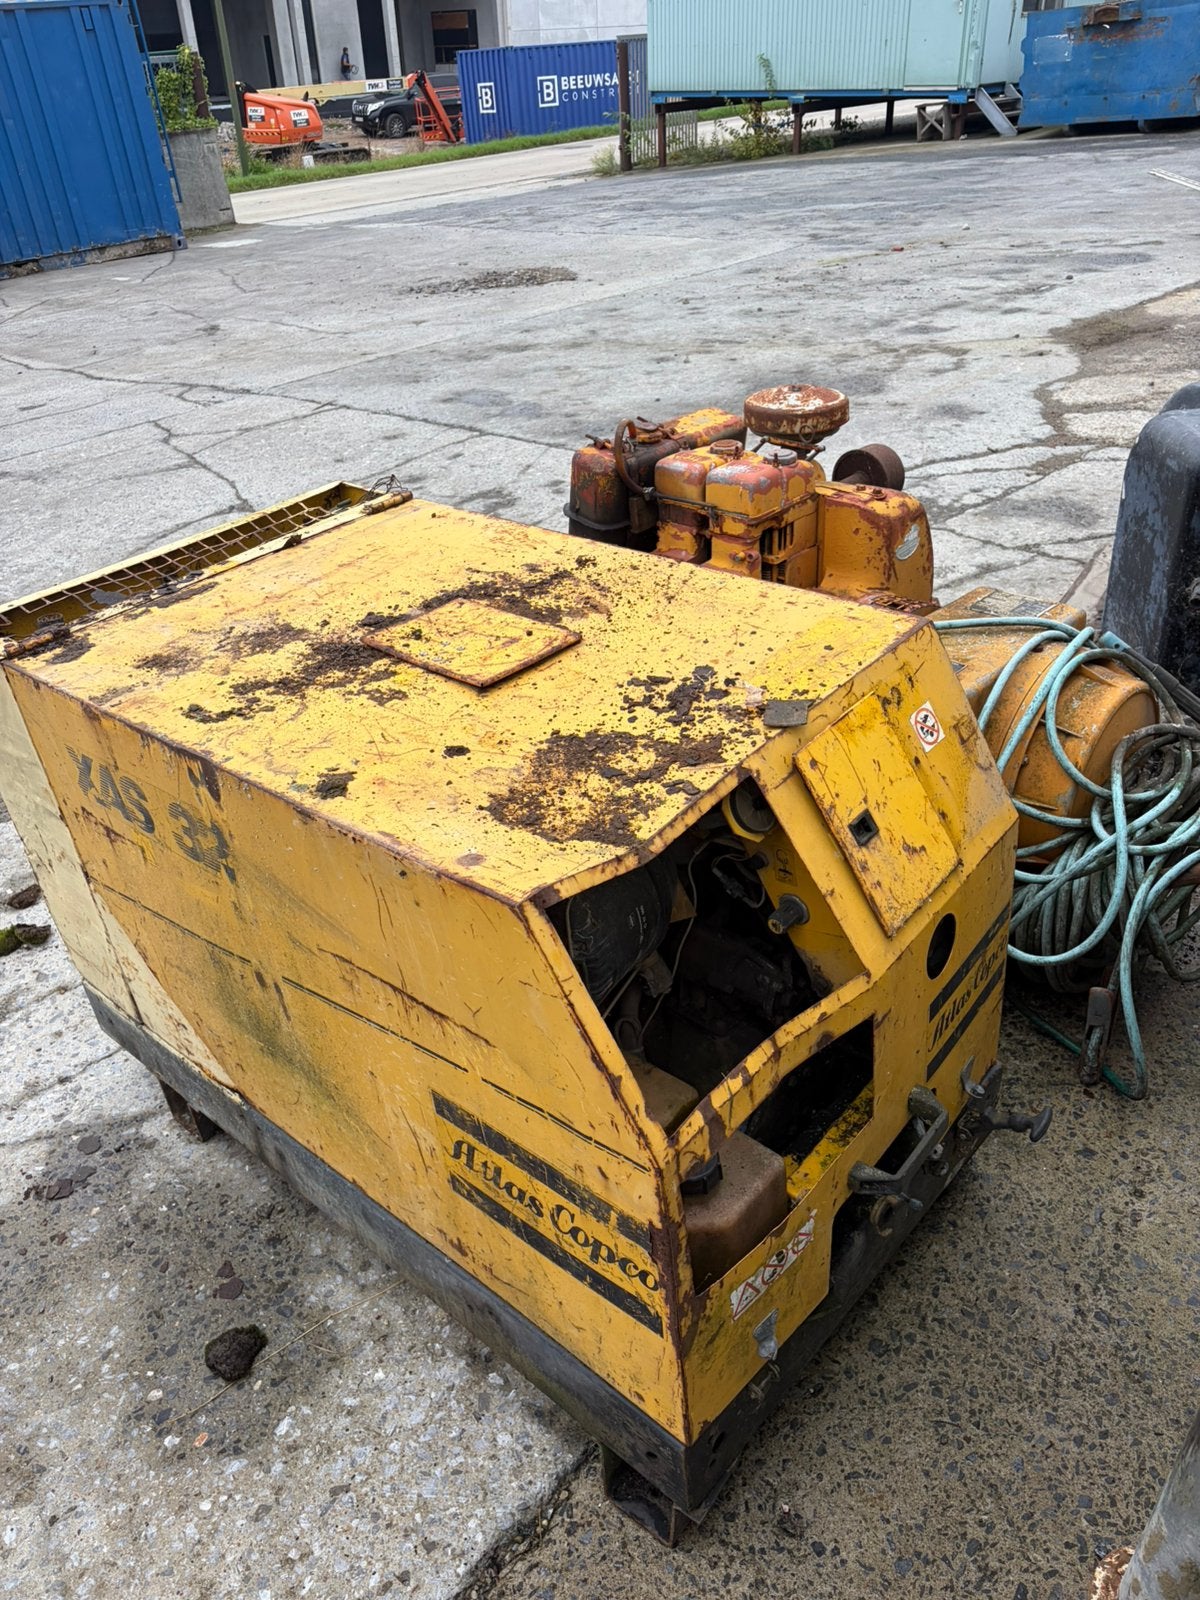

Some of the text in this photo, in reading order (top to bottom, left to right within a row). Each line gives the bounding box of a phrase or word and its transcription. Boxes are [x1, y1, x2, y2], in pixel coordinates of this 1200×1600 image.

[561, 70, 640, 90] BEEUWSA
[562, 84, 639, 102] CONSTR
[928, 989, 972, 1053] Atlas
[449, 1139, 660, 1292] Atlas Copco
